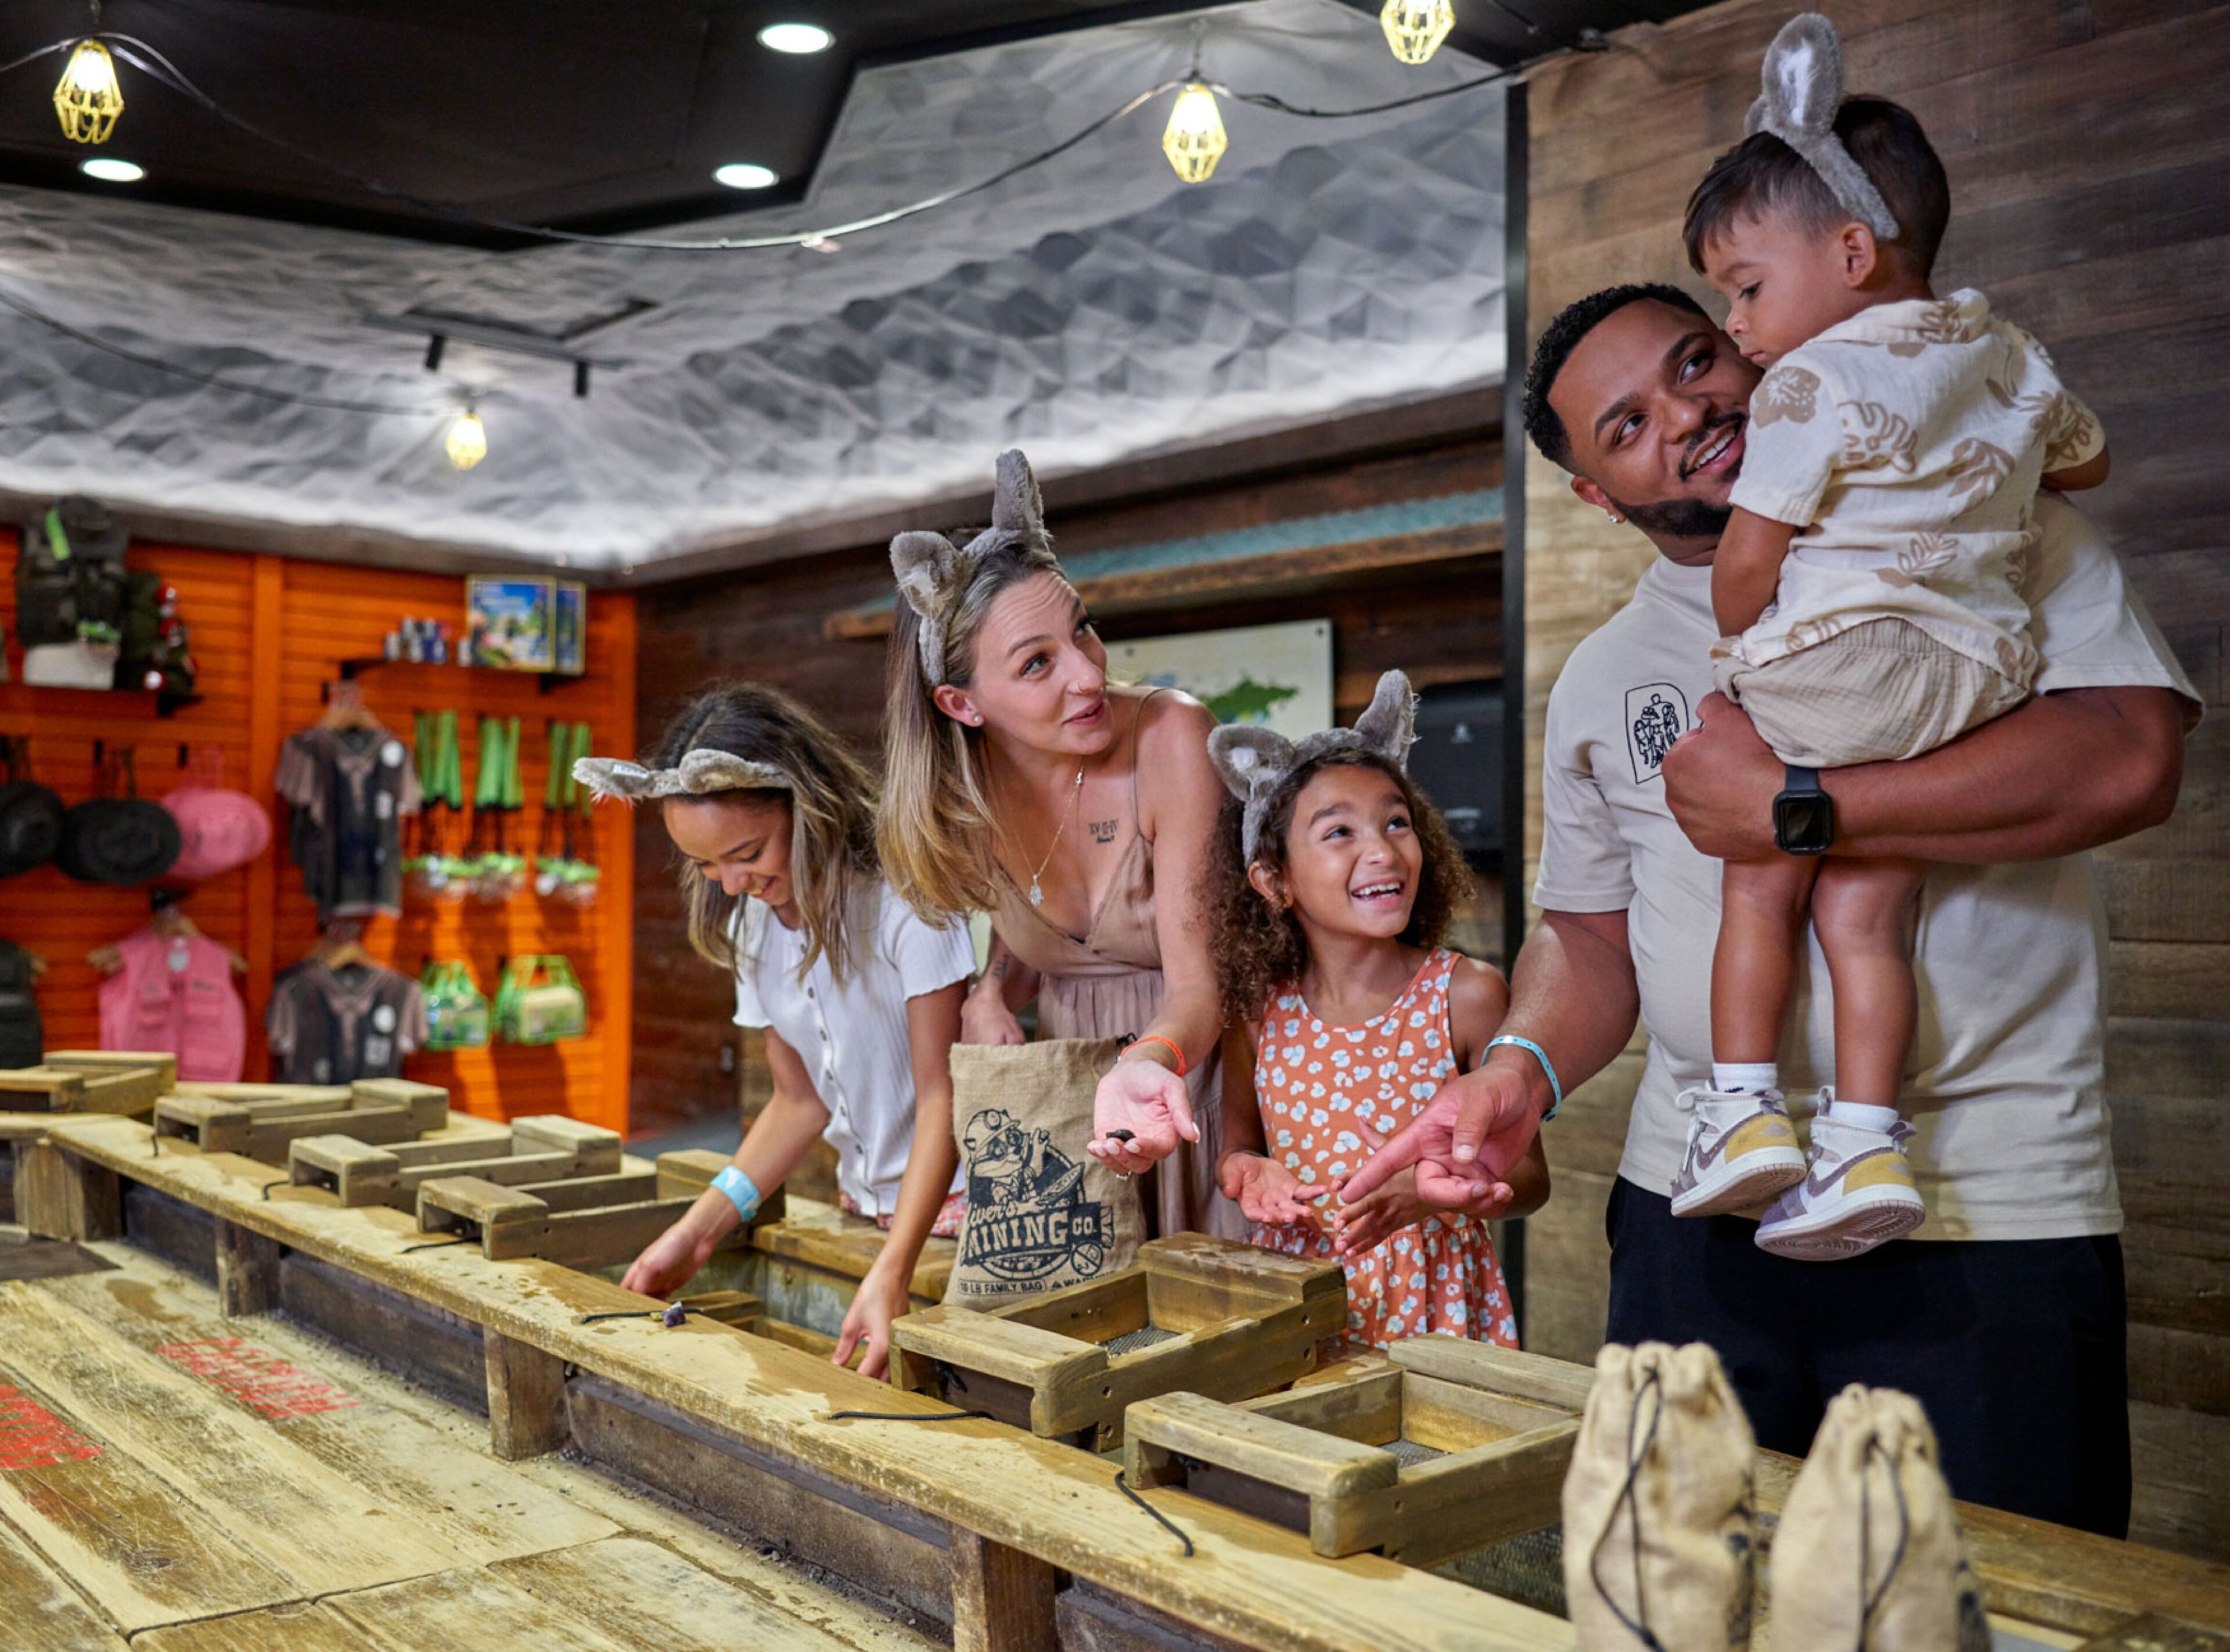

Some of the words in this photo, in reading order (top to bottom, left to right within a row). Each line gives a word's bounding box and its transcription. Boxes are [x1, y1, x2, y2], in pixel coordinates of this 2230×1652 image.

[970, 1283, 981, 1293] LB
[984, 1283, 1016, 1293] FAMILY
[1020, 1281, 1043, 1292] BAG
